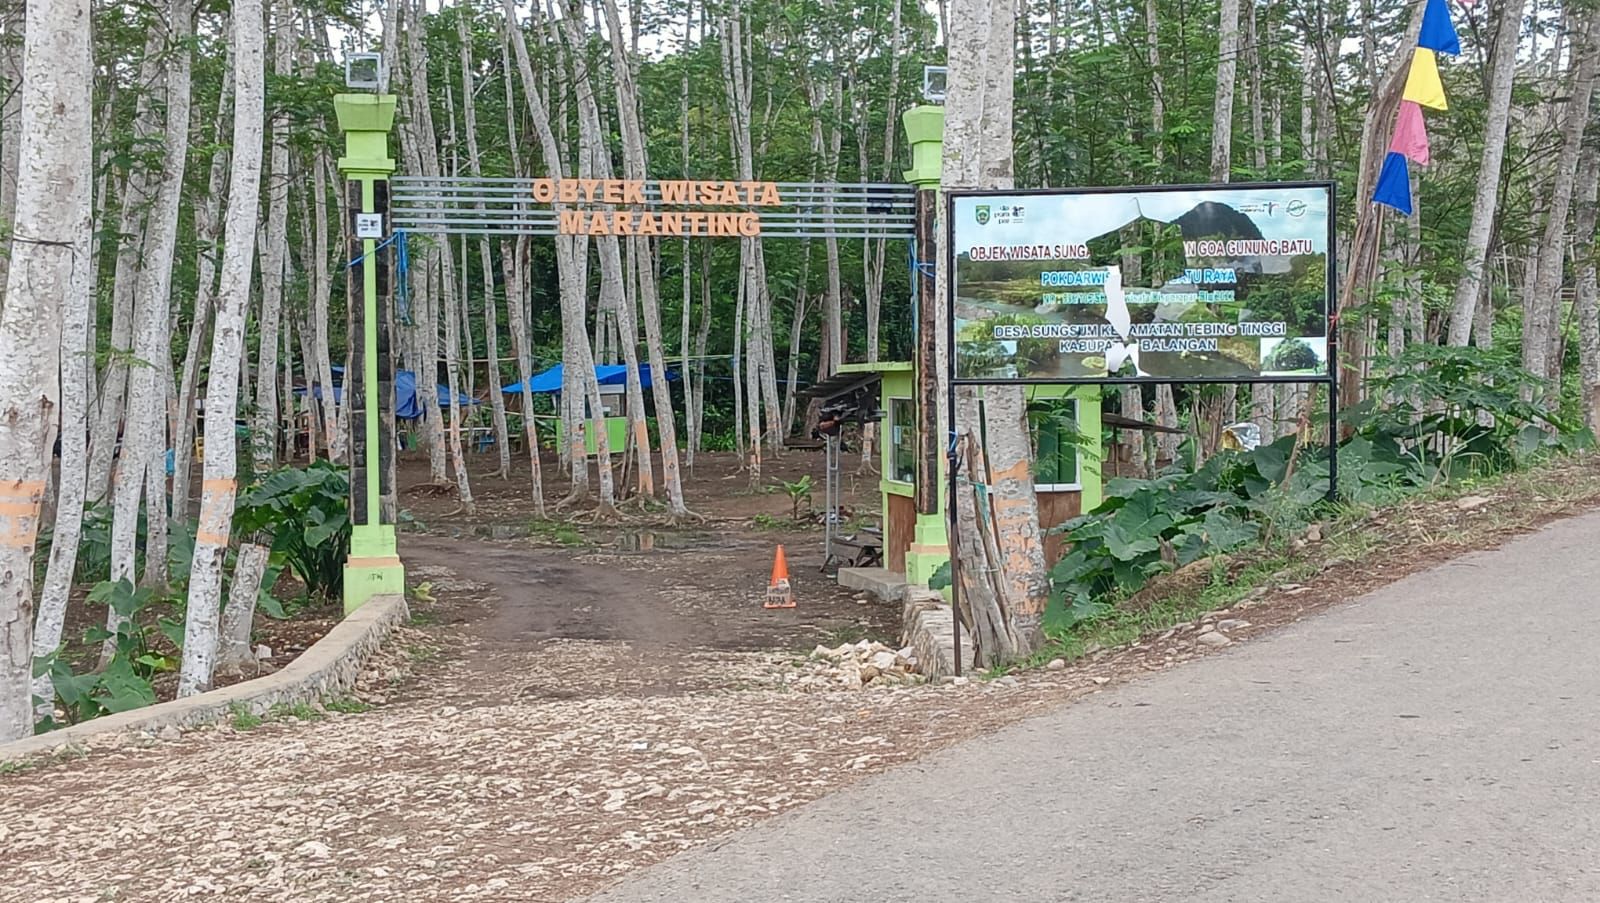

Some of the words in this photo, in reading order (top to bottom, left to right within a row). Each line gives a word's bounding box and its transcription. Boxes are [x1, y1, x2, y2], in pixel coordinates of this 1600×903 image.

[532, 178, 645, 205] OBYEK
[659, 180, 782, 207] WISATA
[559, 210, 761, 237] MARANTING
[970, 246, 1009, 260] OBJEK
[1010, 245, 1050, 259] WISATA
[1198, 241, 1225, 256] GOA
[1227, 240, 1278, 255] GUNUNG
[1281, 239, 1312, 254] BATU
[1204, 270, 1235, 282] RAYA
[995, 325, 1030, 338] DESA
[1032, 325, 1099, 338] SUNGSUM
[1101, 323, 1183, 337] KEAMATAN
[1187, 322, 1236, 336] TEBING
[1240, 321, 1286, 335] TINGGI
[1142, 339, 1217, 351] BALANGAN
